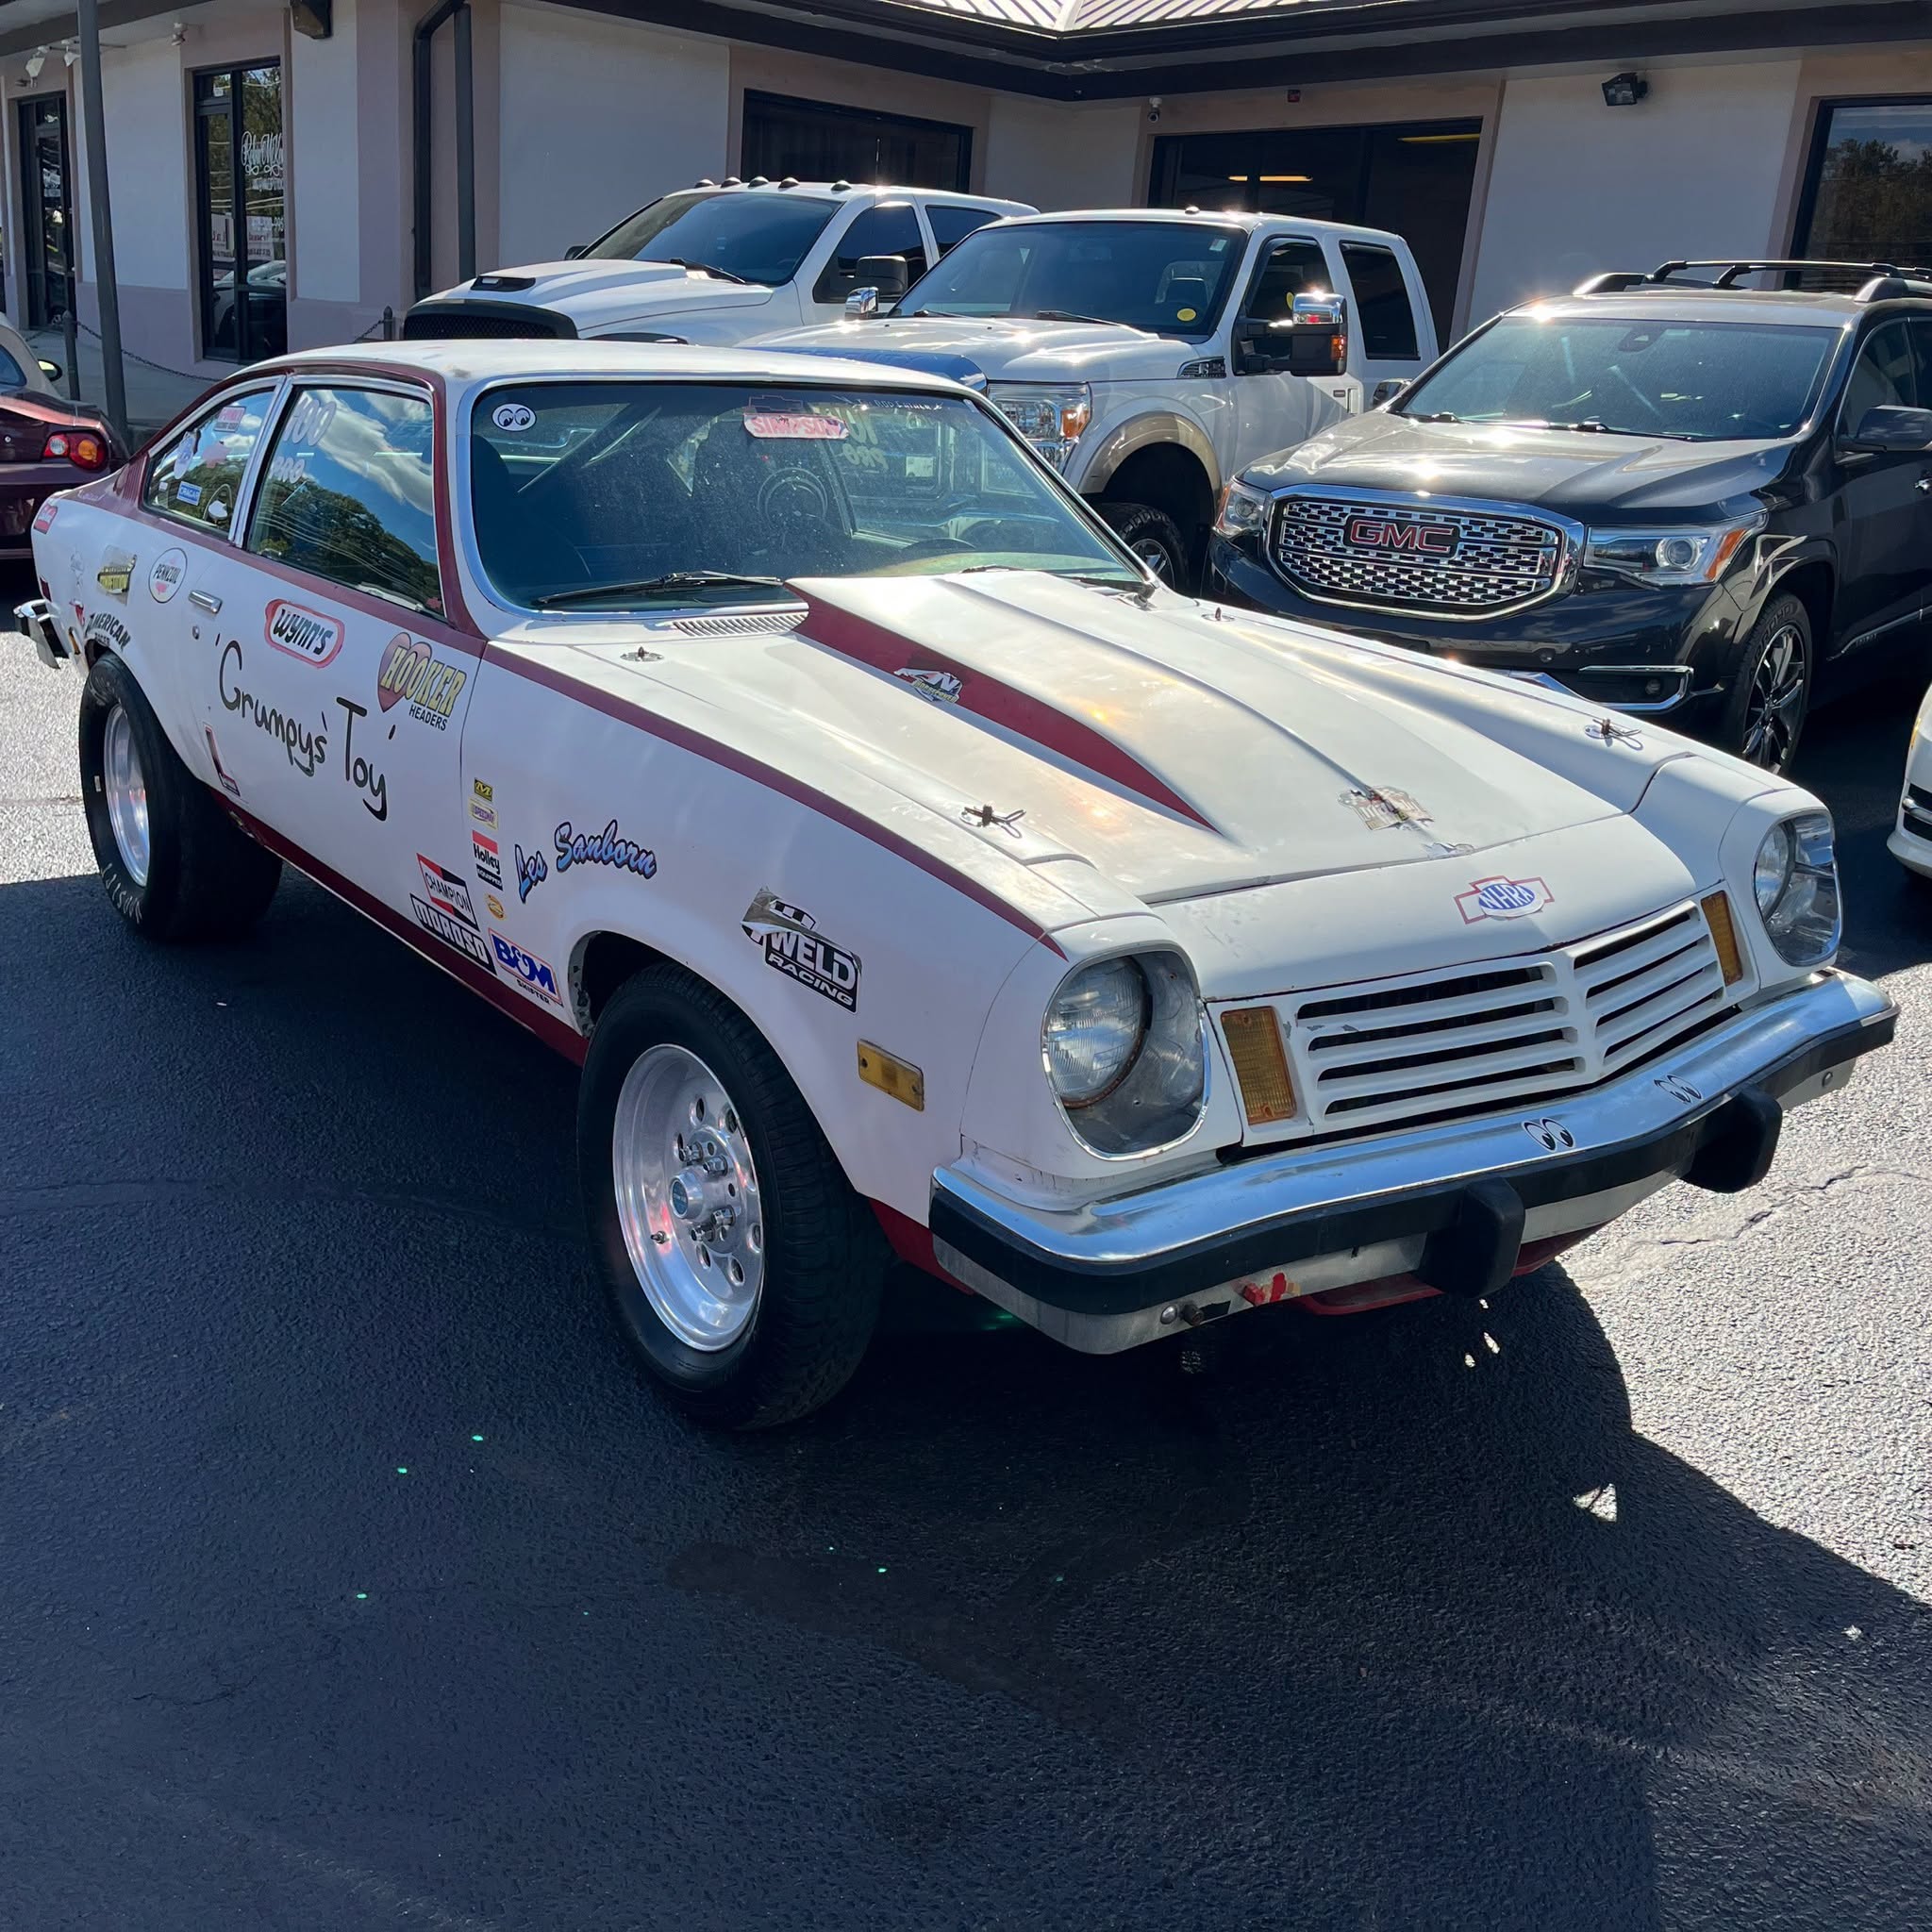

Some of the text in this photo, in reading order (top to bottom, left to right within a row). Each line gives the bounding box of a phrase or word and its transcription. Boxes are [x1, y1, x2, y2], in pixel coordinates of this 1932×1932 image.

[1350, 520, 1456, 553] GMC
[85, 612, 131, 651] AMERICAN
[379, 644, 467, 718] HOOKER
[408, 705, 448, 732] HEADERS
[474, 841, 501, 875] Holley
[554, 819, 658, 880] Sanborn
[425, 871, 473, 914] CHAMPION
[1481, 884, 1535, 909] NHRA
[412, 896, 490, 966] MOROSO
[491, 933, 558, 996] B&M
[768, 952, 854, 1007] RACING
[770, 930, 856, 991] WELD
